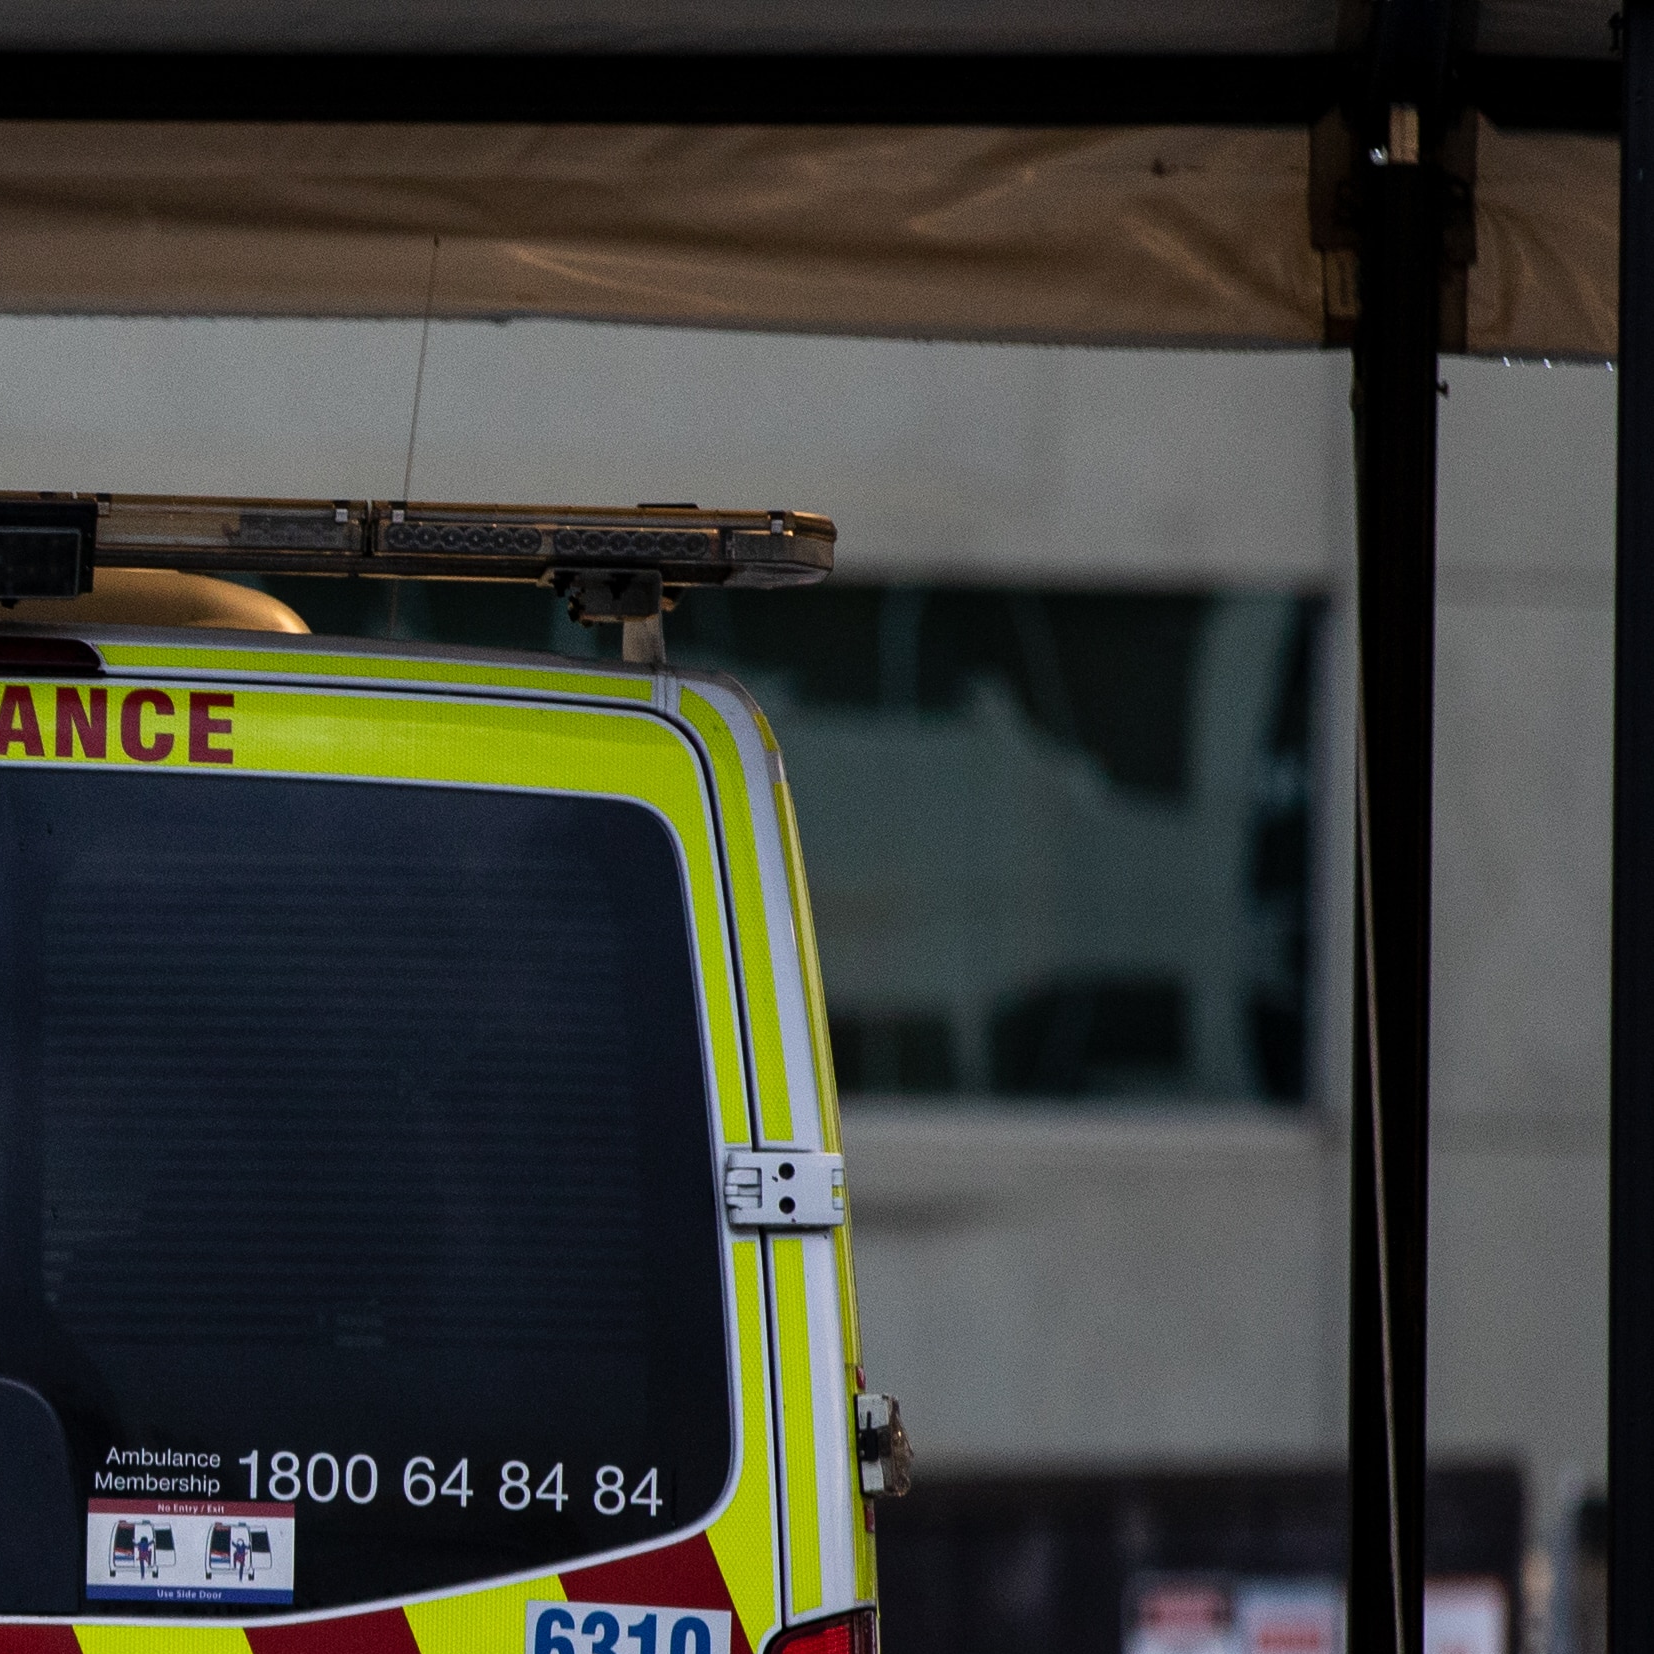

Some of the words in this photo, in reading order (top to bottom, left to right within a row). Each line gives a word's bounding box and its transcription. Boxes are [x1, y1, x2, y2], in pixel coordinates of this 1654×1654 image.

[105, 1446, 222, 1469] Ambulance
[93, 1471, 221, 1495] Membership
[238, 1449, 379, 1504] 1800
[402, 1457, 474, 1508] 64
[498, 1461, 569, 1512] 84
[593, 1465, 664, 1517] 84
[157, 1504, 171, 1513] No
[173, 1504, 198, 1515] Entry
[206, 1504, 225, 1514] Exit
[156, 1590, 174, 1599] Use
[176, 1590, 197, 1599] Side
[199, 1591, 223, 1600] Door
